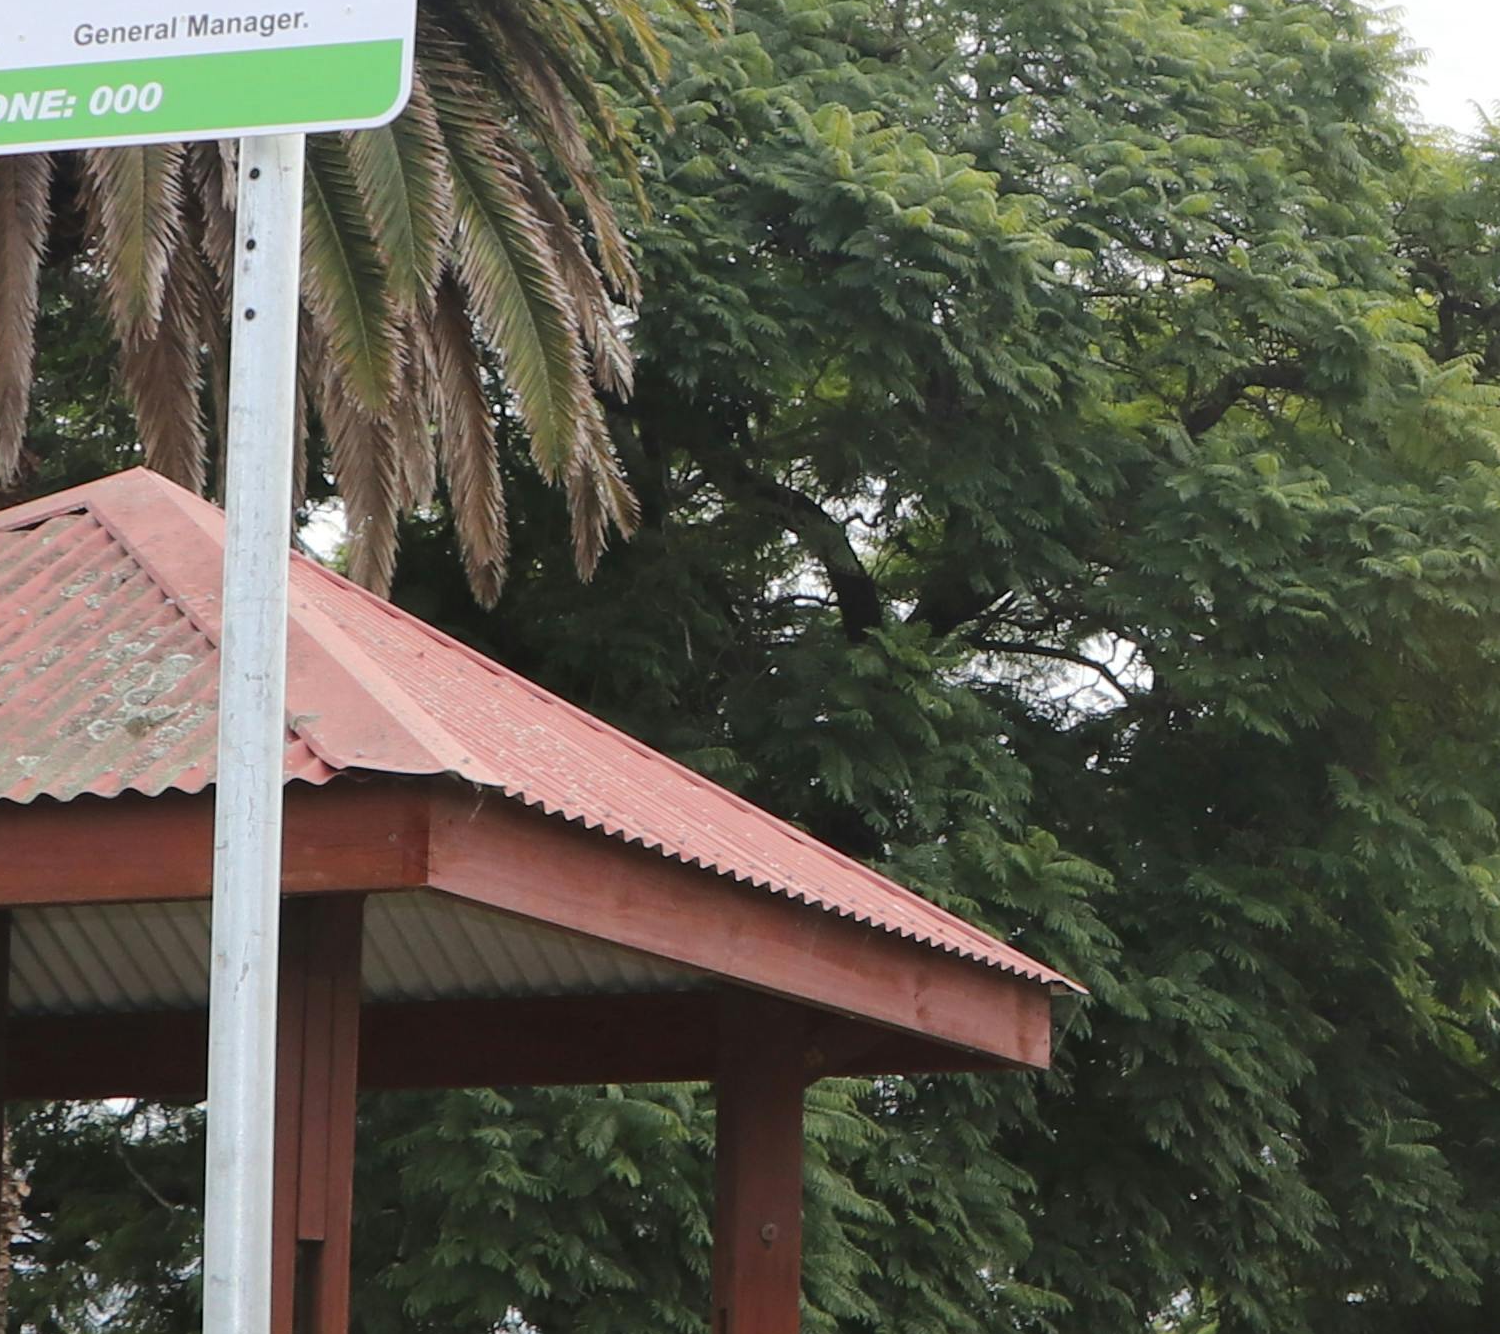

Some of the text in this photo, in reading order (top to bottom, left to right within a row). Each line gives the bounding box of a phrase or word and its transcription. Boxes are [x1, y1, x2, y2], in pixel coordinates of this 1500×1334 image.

[73, 11, 308, 46] General Manager.
[88, 81, 163, 115] 000
